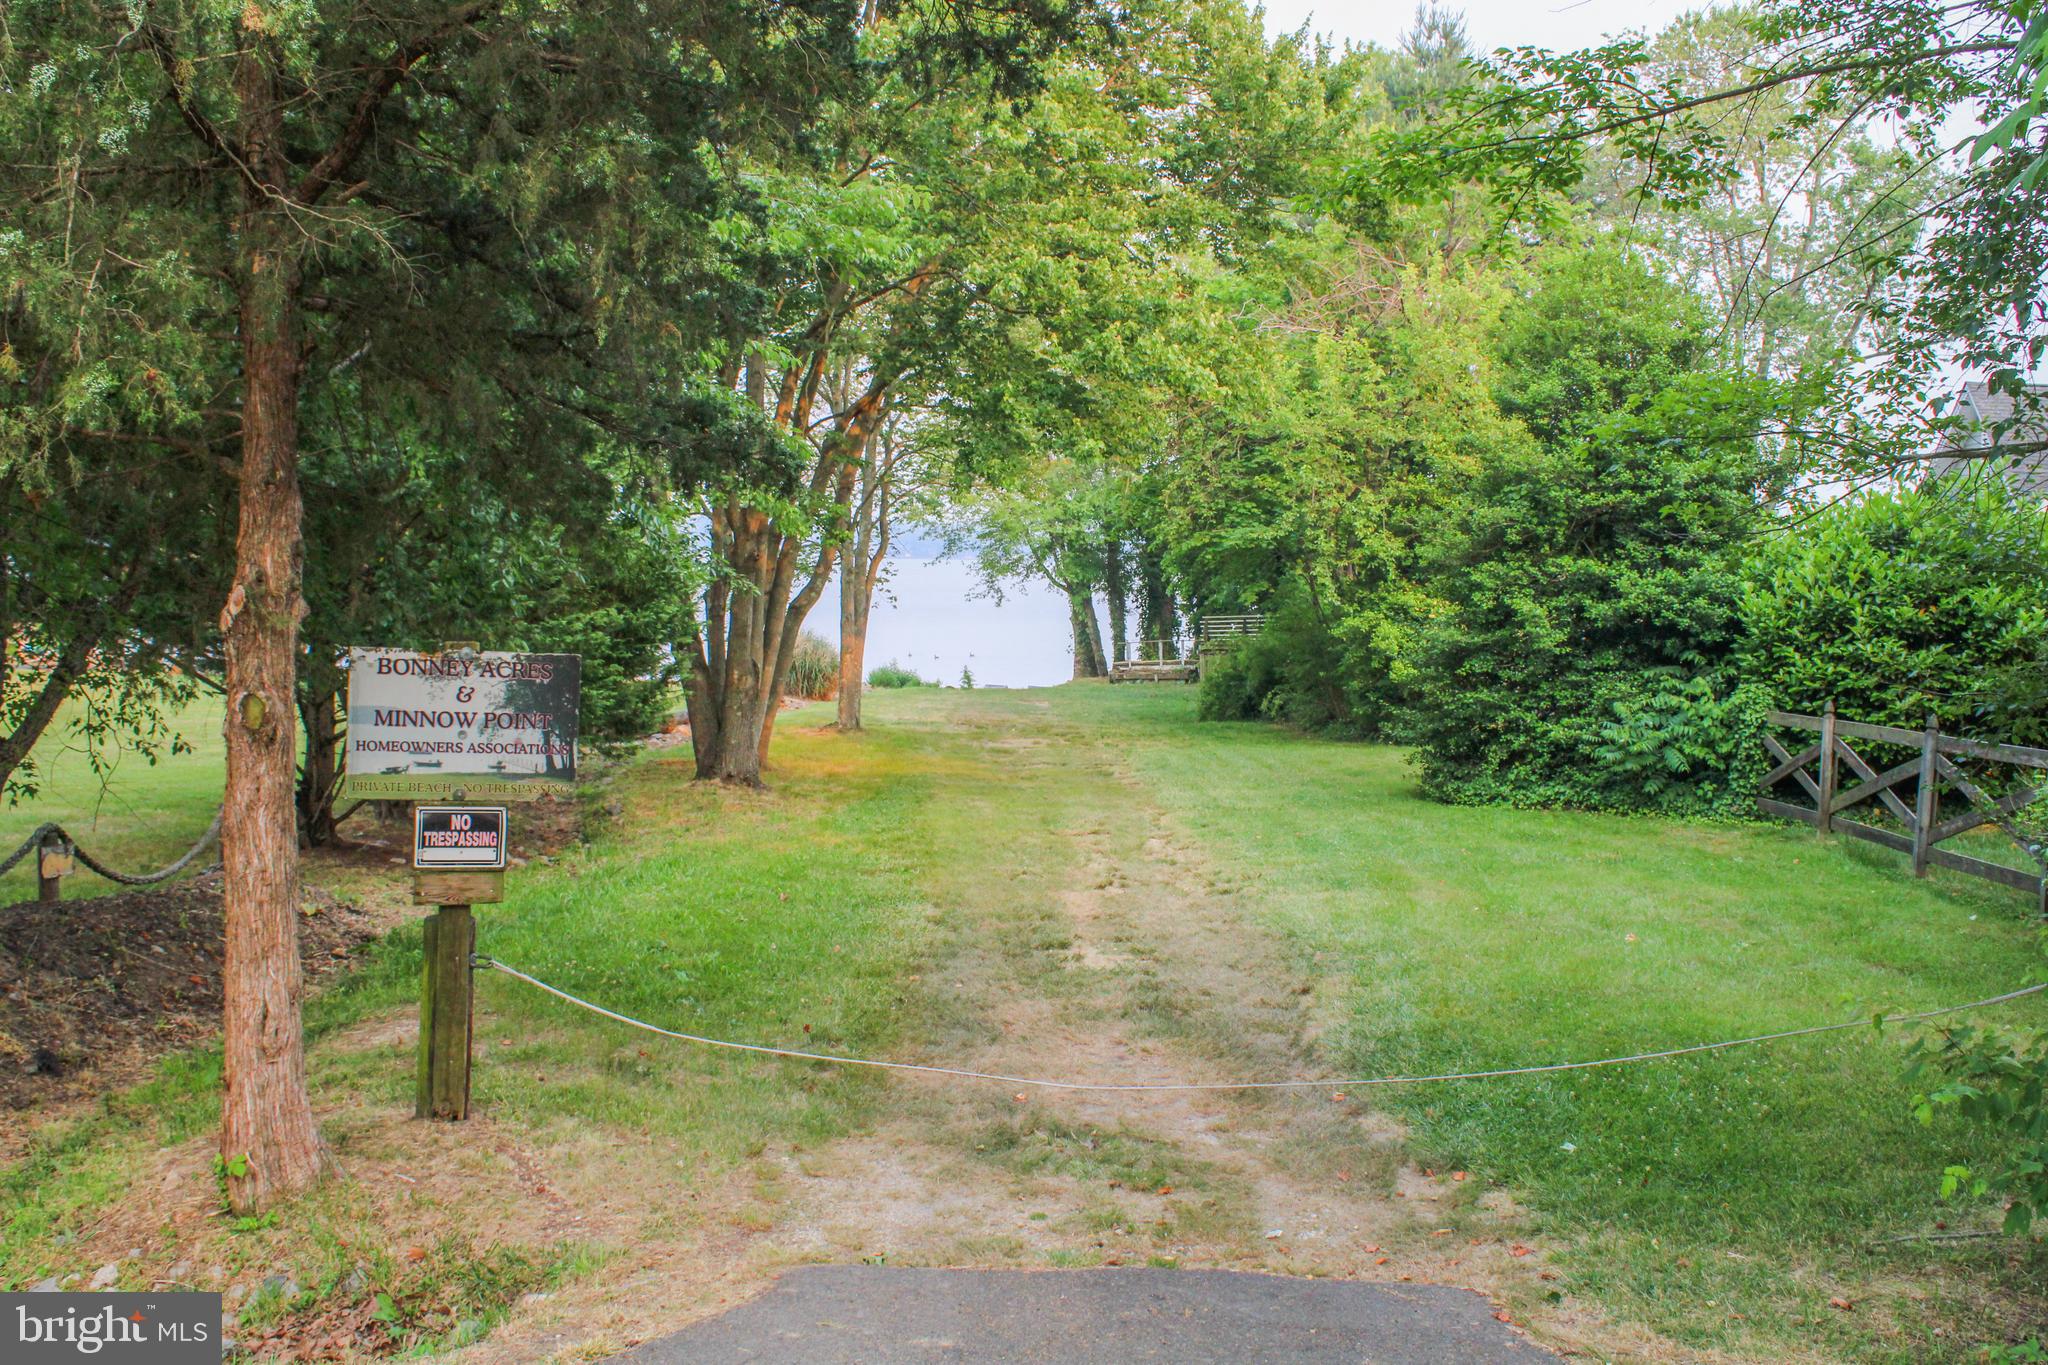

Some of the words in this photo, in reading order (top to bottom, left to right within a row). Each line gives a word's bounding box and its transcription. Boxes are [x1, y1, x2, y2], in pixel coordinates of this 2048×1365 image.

[378, 657, 474, 677] BONNEY
[480, 661, 553, 680] ACRES
[456, 685, 475, 703] &
[374, 709, 477, 728] MINNOW
[484, 712, 553, 730] POINT
[355, 740, 463, 753] HOMEOWNERS
[467, 742, 570, 756] ASSOCIATIONS
[352, 782, 406, 792] PRIVATE
[408, 782, 452, 793] BEACH
[464, 783, 482, 793] NO
[487, 783, 570, 794] TRESPASSING
[450, 814, 472, 830] NO
[424, 831, 497, 847] TRESPASSING
